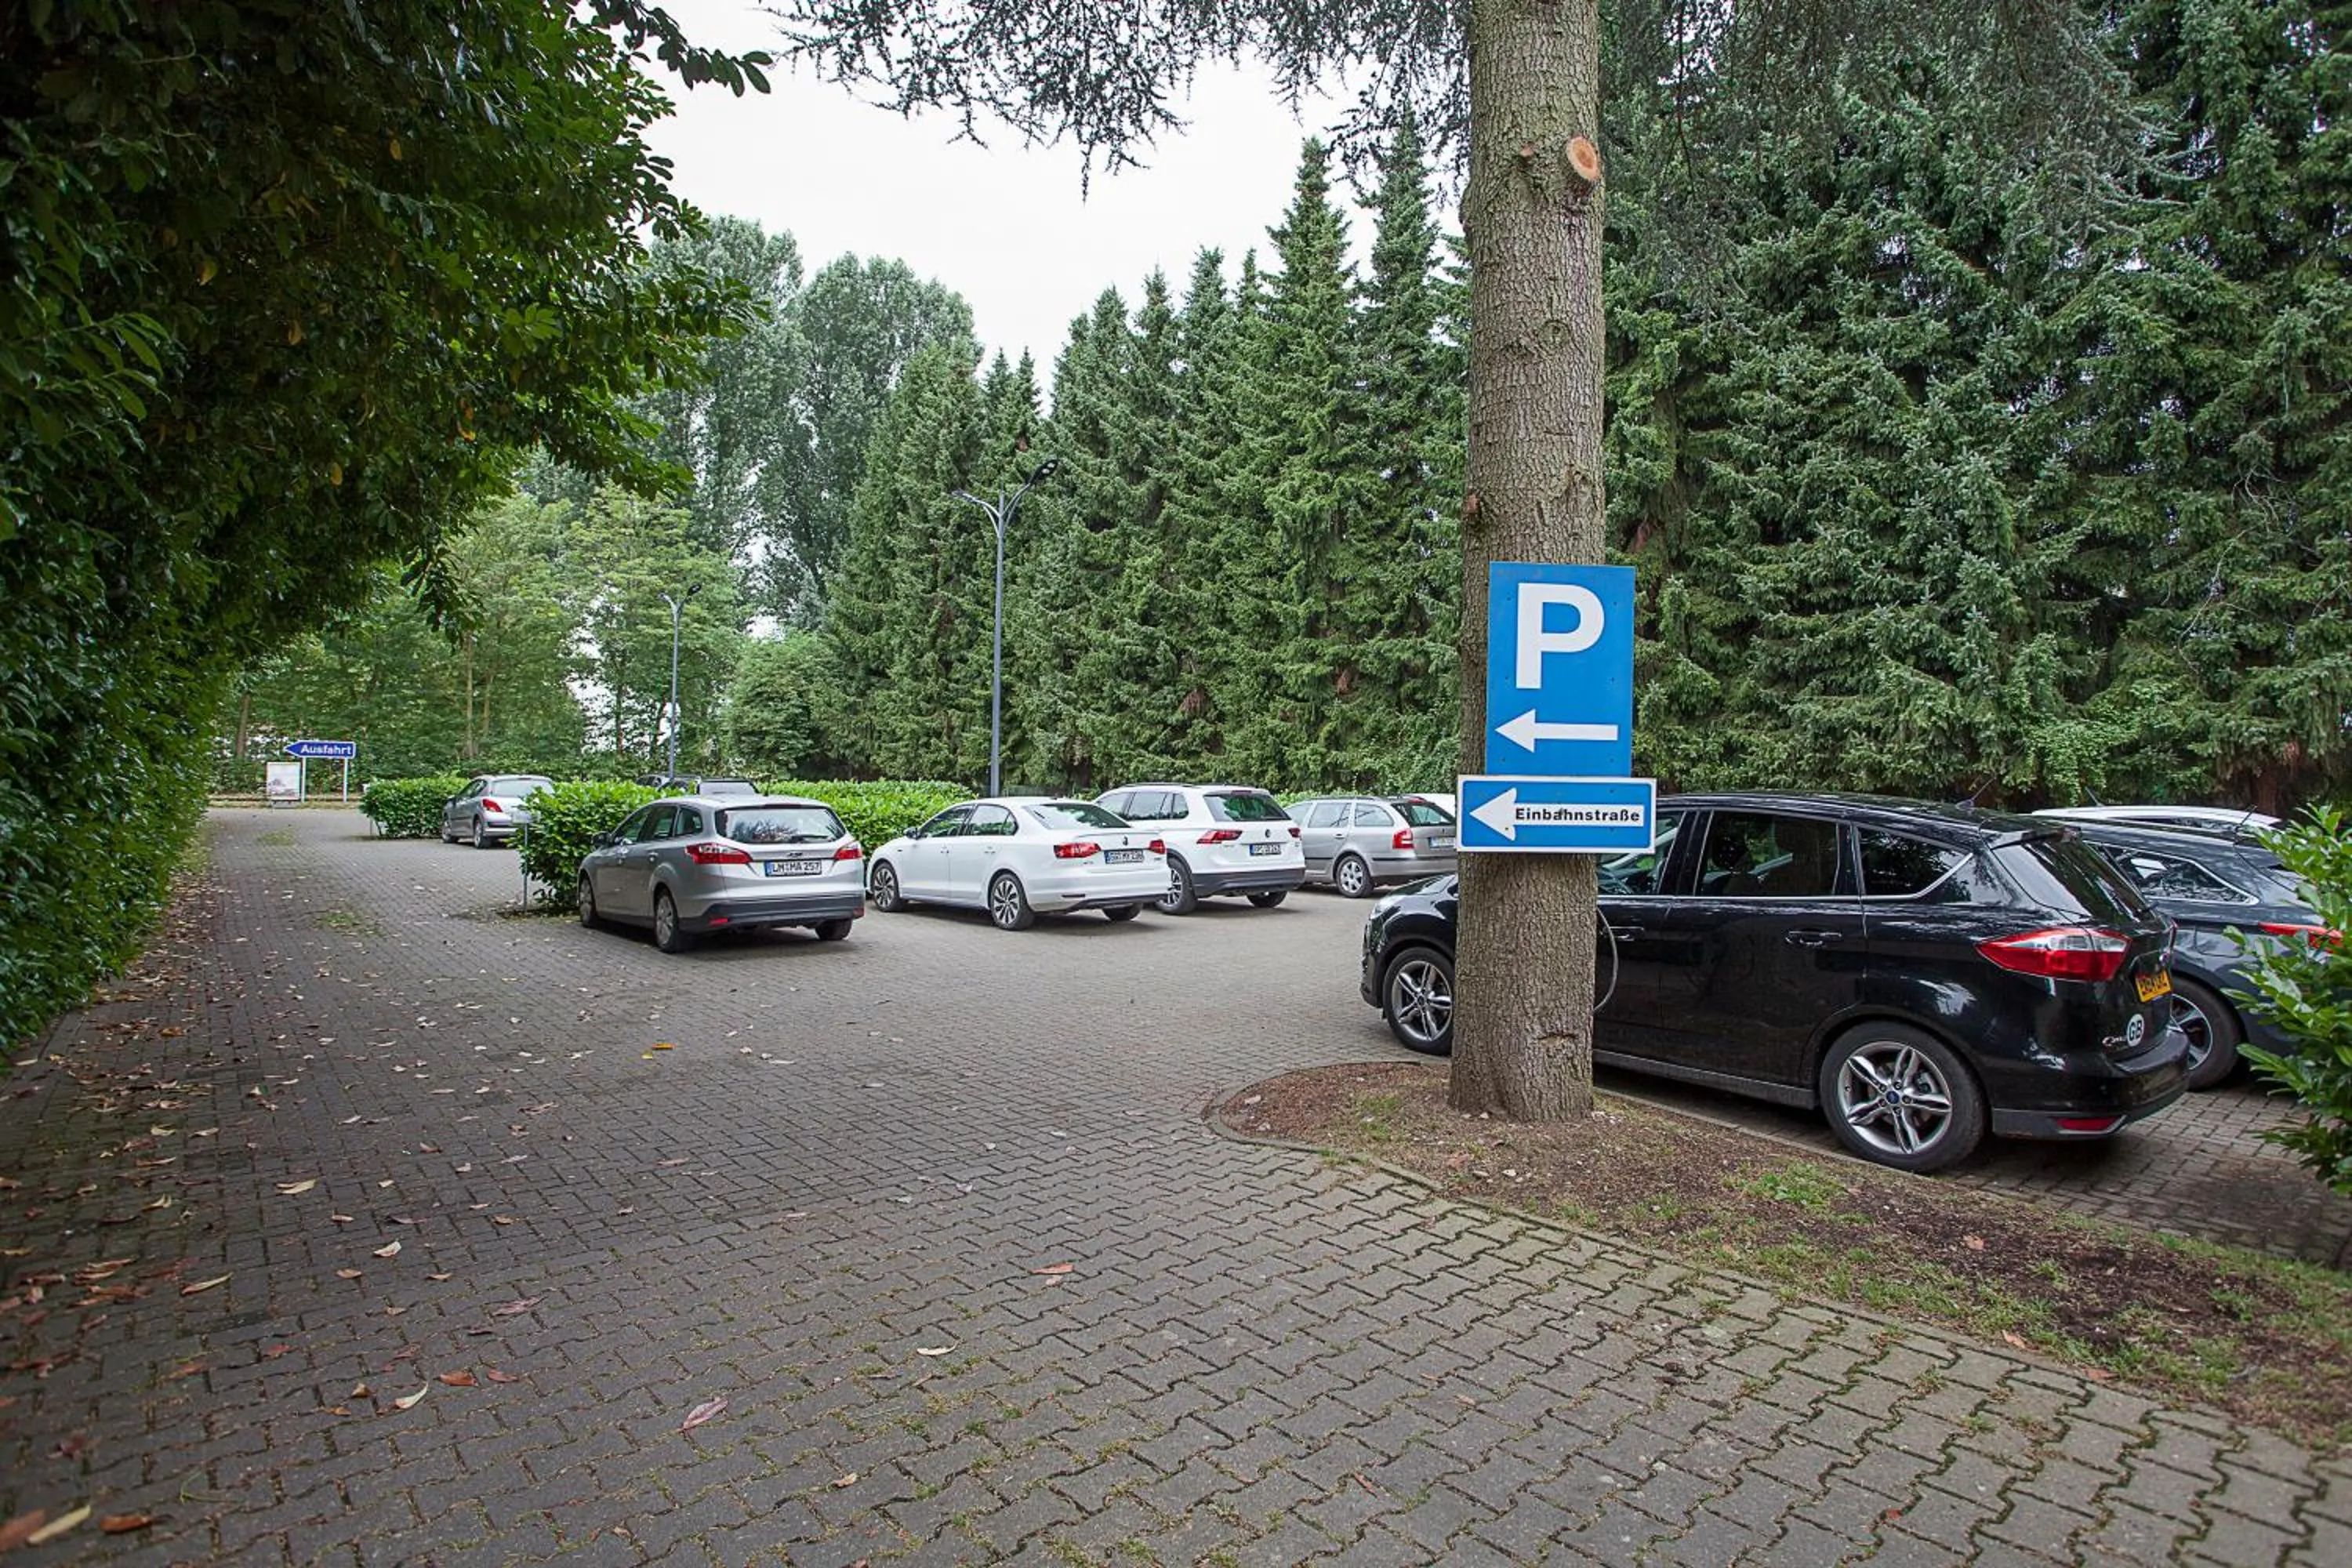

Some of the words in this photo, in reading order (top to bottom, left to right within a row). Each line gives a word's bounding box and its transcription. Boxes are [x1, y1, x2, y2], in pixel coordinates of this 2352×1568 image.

[1516, 583, 1605, 689] P
[300, 744, 352, 754] Ausfahrt
[1515, 808, 1640, 822] Einbahnstraße
[2129, 1020, 2143, 1040] GB
